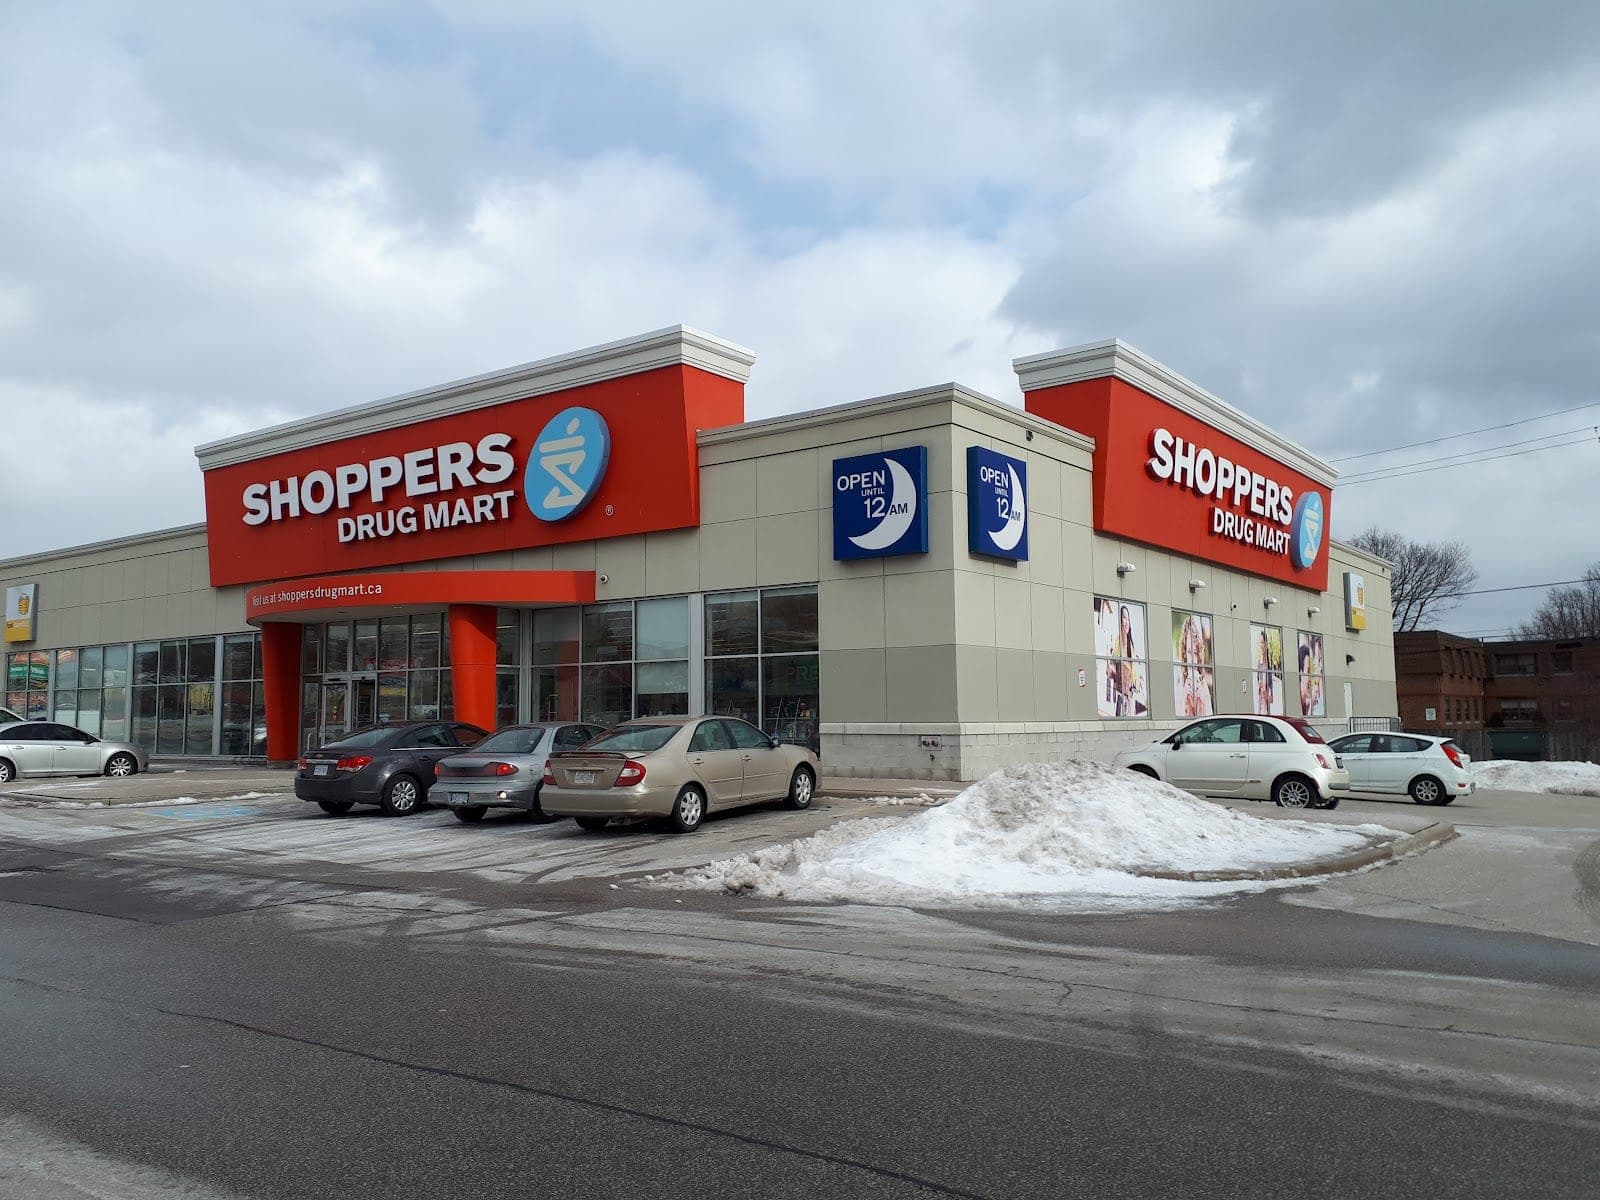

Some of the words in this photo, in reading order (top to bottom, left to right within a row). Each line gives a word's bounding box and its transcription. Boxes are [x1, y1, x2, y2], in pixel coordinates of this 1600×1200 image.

[242, 433, 515, 525] SHOPPERS
[837, 470, 885, 491] OPEN
[980, 466, 1009, 489] OPEN
[1148, 428, 1293, 525] SHOPPERS
[861, 487, 885, 497] UNTIL
[994, 487, 1009, 497] UNTIL
[337, 506, 417, 543] DRUG
[424, 490, 515, 531] MART
[863, 497, 885, 519] 12
[889, 503, 908, 515] AM
[996, 497, 1009, 519] 12
[1010, 510, 1021, 521] AM
[1213, 507, 1254, 544] DRUG
[1256, 523, 1291, 555] MART
[270, 591, 277, 603] at
[278, 584, 382, 602] shoppersdrugmart.ca
